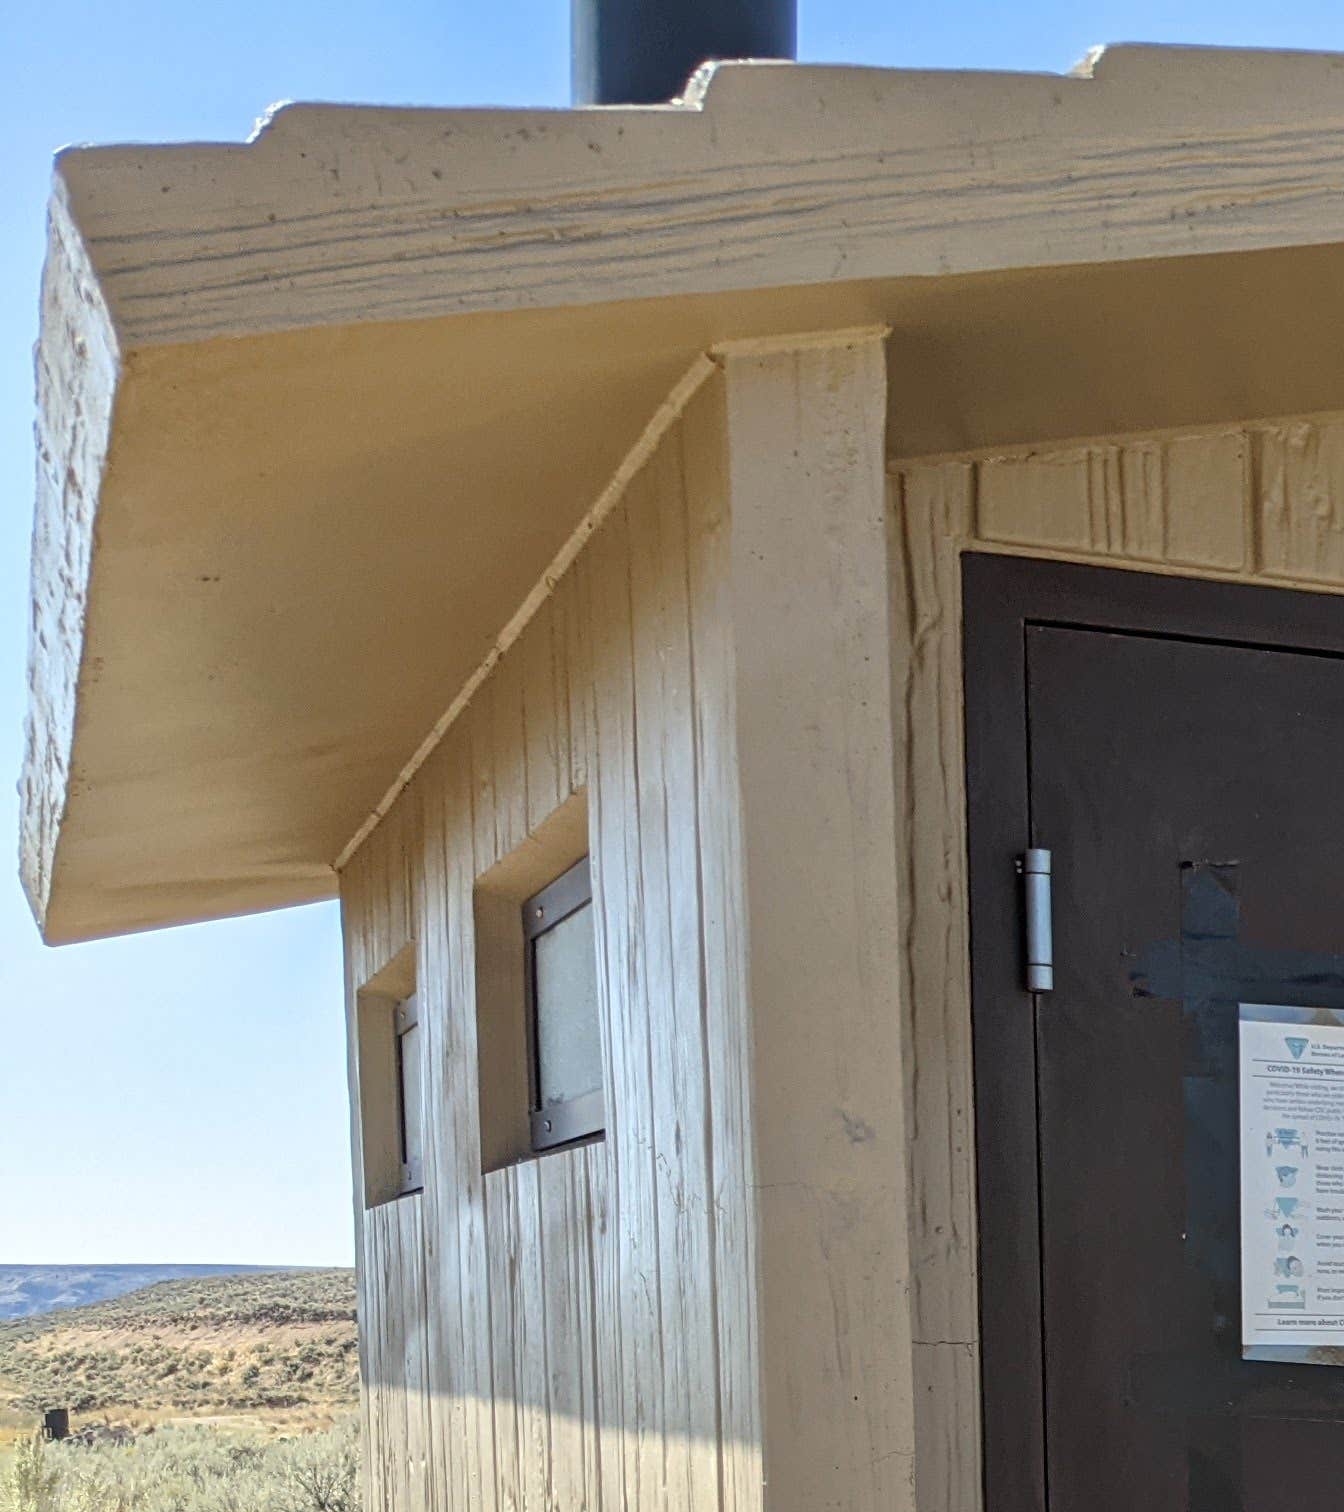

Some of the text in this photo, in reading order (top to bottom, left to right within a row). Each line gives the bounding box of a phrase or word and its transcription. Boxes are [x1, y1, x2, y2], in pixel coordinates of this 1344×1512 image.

[1267, 1065, 1301, 1073] COVID-19
[1301, 1067, 1323, 1076] Safety
[1324, 1068, 1344, 1076] When
